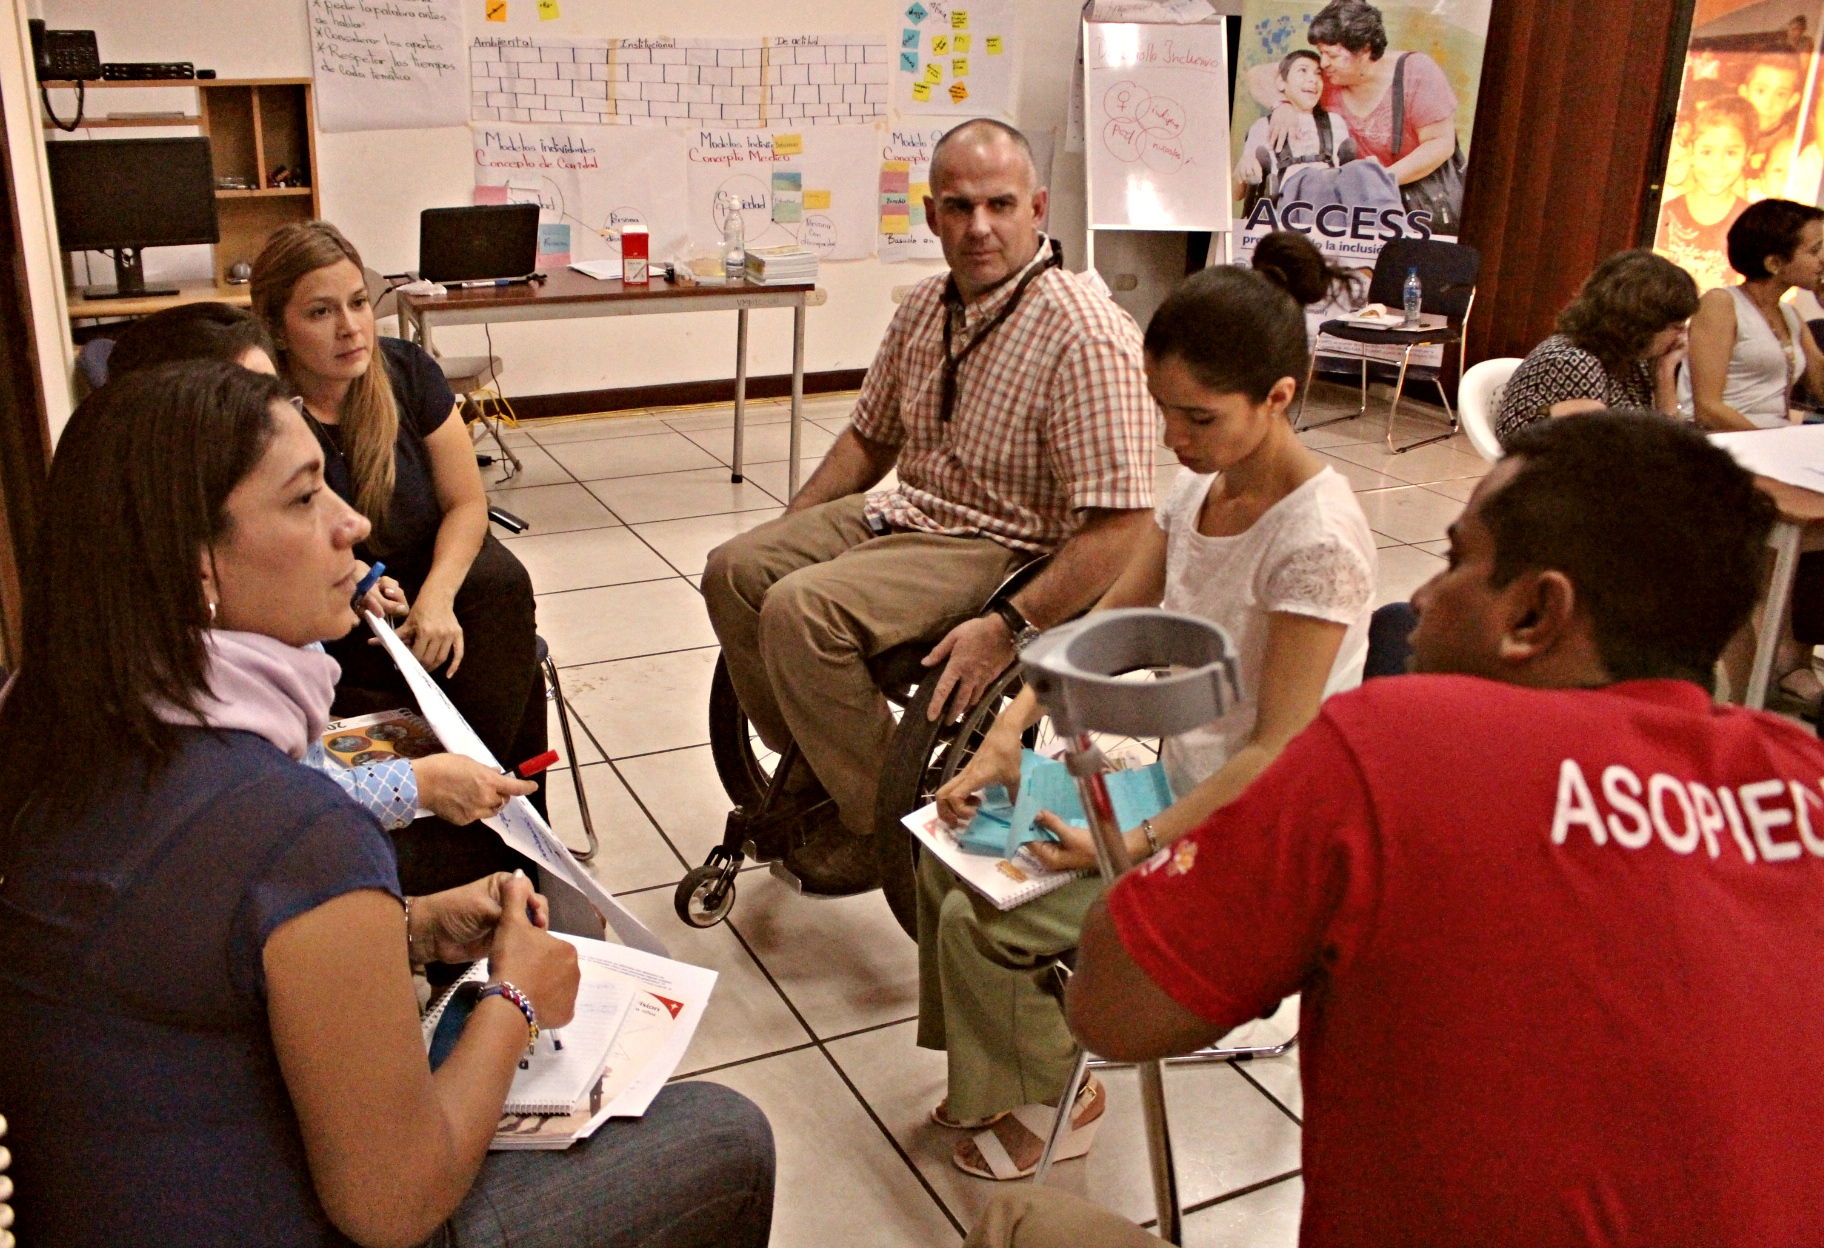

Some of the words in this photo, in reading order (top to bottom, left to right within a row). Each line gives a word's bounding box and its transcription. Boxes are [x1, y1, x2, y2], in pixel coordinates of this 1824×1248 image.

[418, 5, 447, 21] antes
[384, 33, 402, 48] los
[473, 36, 533, 48] Ambiental
[390, 50, 408, 67] los
[411, 53, 456, 77] tiempos
[475, 148, 535, 169] Concepto
[688, 147, 744, 167] Concepto
[883, 146, 929, 165] Concepto
[1245, 198, 1432, 242] ACCESS
[1326, 241, 1335, 251] la
[1339, 242, 1384, 254] inclusió
